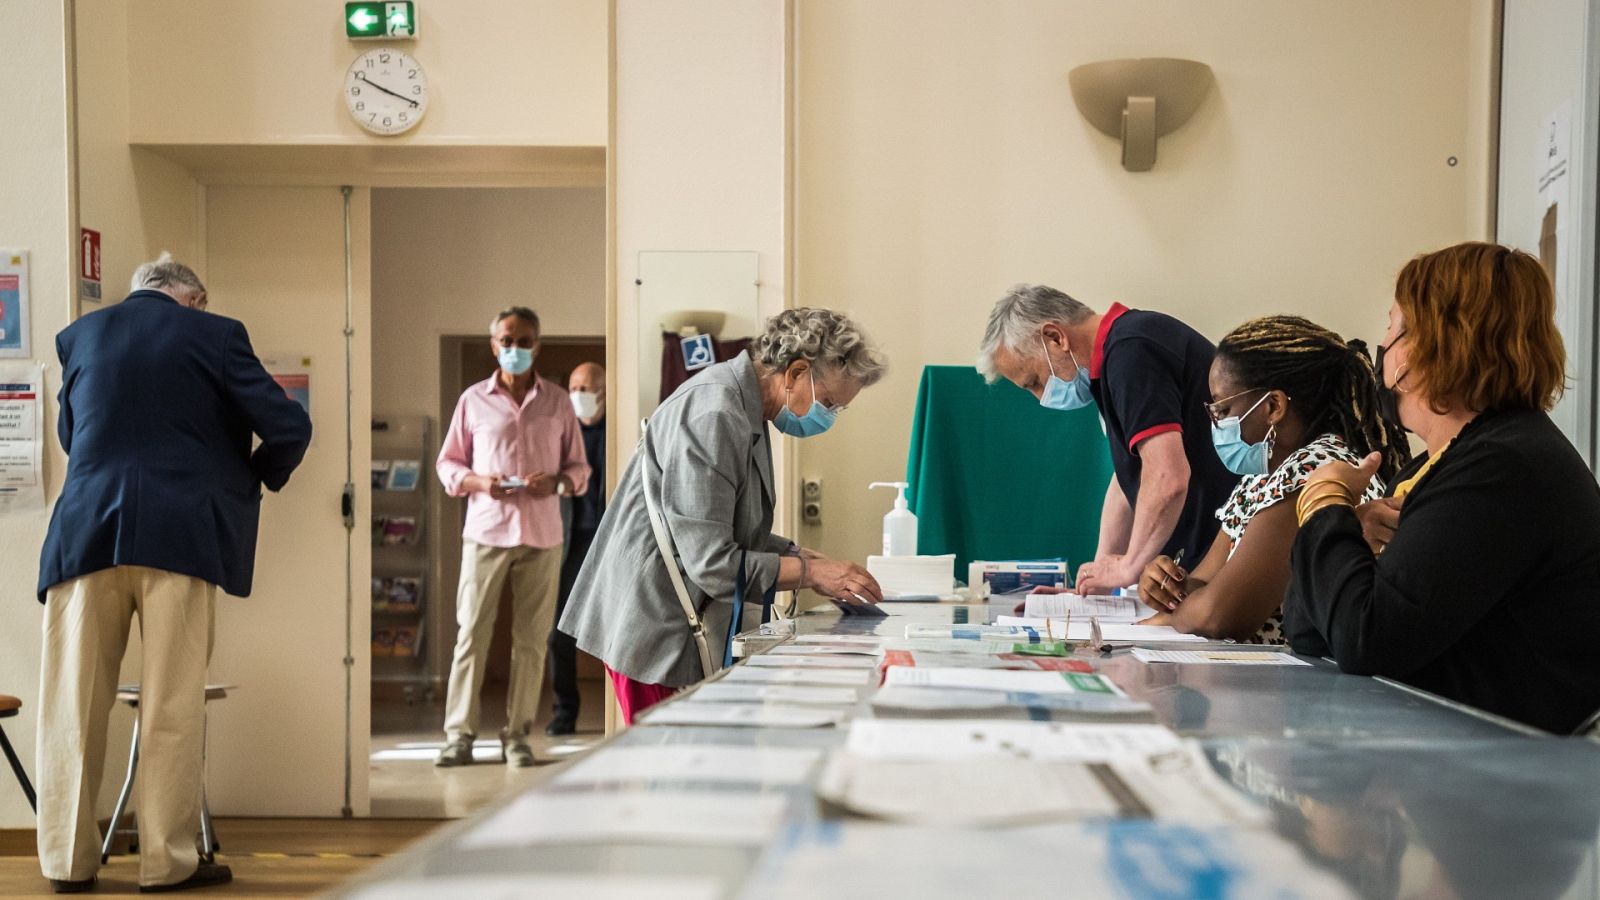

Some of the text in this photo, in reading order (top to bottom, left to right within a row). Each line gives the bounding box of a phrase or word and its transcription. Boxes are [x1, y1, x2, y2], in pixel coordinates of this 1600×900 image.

[366, 59, 374, 68] 11
[379, 54, 391, 64] 12
[399, 58, 403, 67] 1
[354, 70, 366, 80] 10
[408, 69, 417, 79] 2
[351, 86, 360, 96] 9
[412, 85, 421, 95] 3
[356, 102, 365, 111] 8
[369, 112, 377, 123] 7
[383, 117, 392, 127] 6
[399, 112, 408, 122] 5
